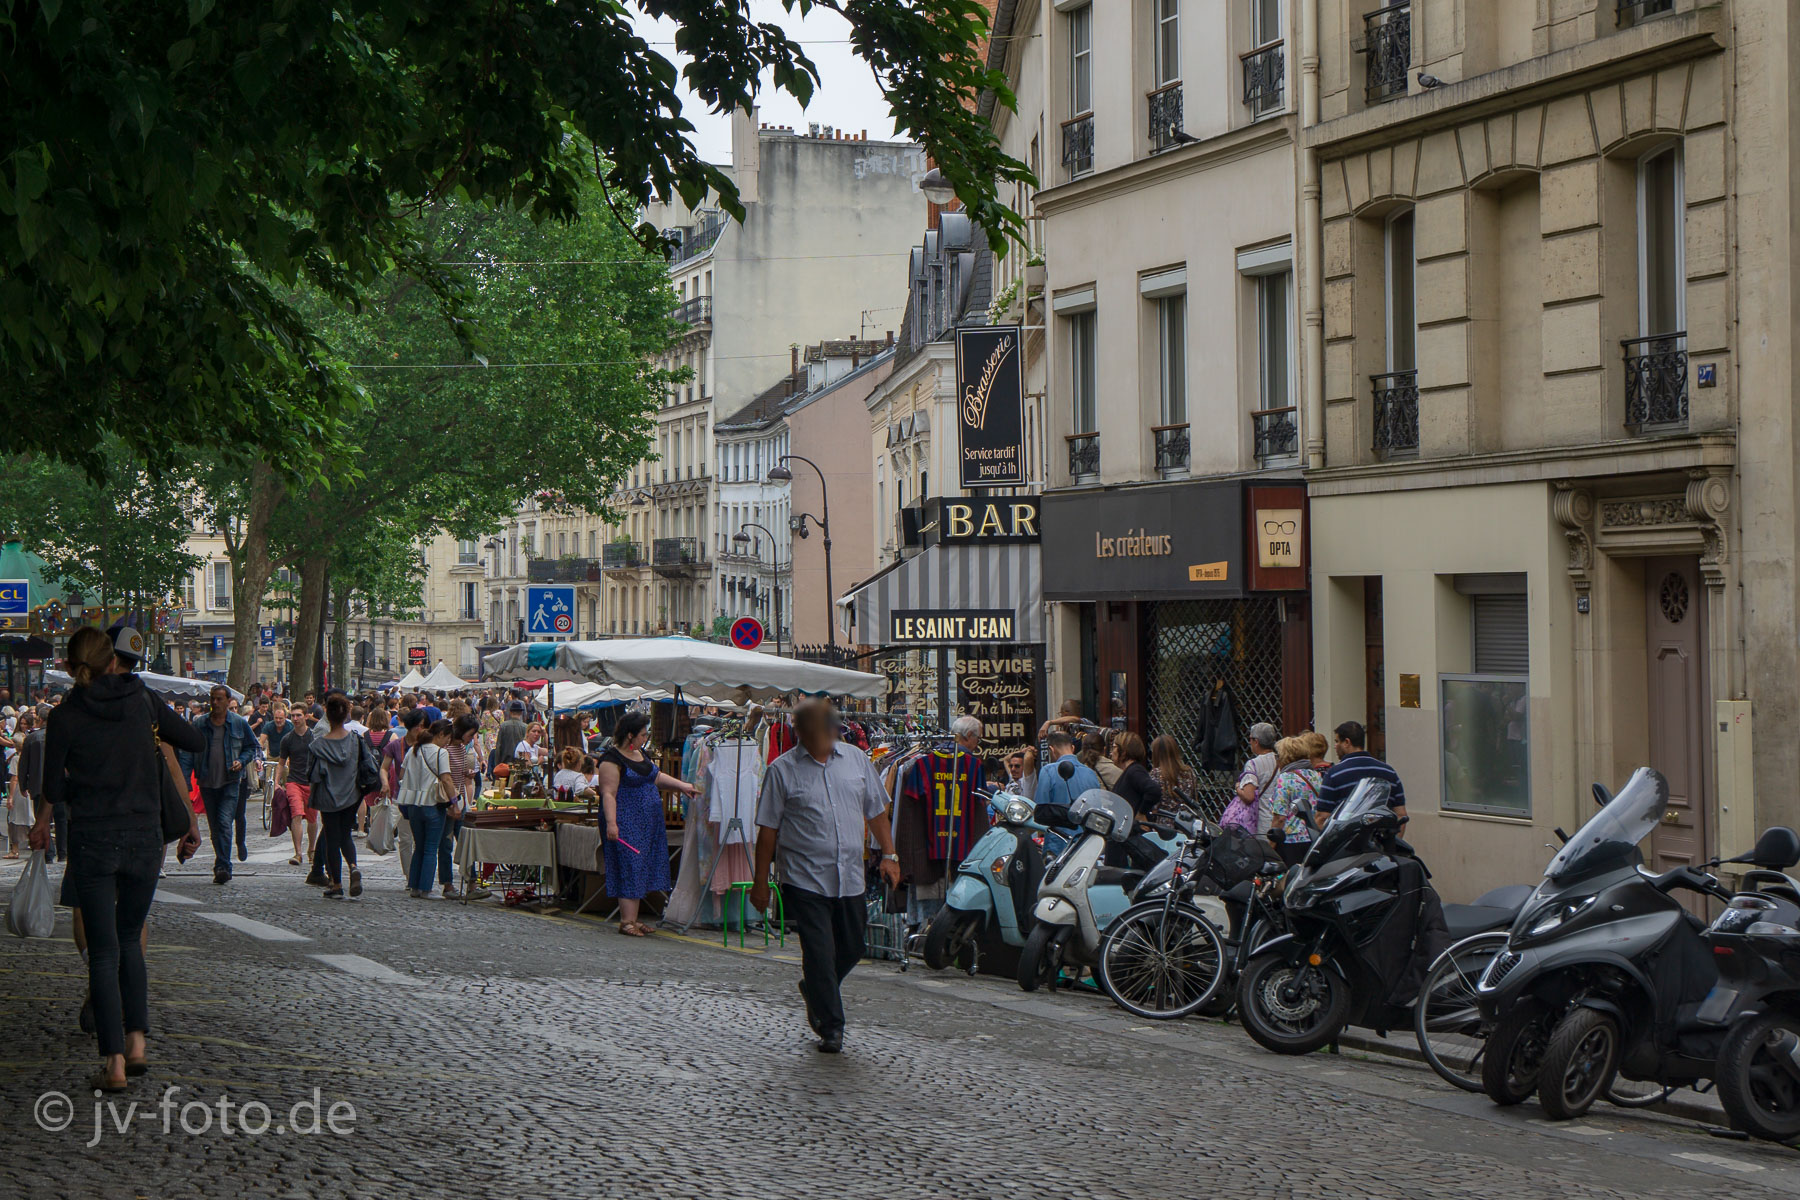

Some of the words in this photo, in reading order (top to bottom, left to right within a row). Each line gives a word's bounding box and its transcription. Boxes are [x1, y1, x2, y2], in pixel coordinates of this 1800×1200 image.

[963, 334, 1012, 429] Brasserie
[1699, 366, 1713, 384] 27
[964, 447, 993, 460] Service
[993, 446, 1016, 459] tardif
[979, 462, 1007, 478] jusqu'à
[1007, 462, 1017, 475] 1h
[945, 503, 1038, 538] BAR
[1096, 531, 1115, 558] Les
[1116, 527, 1172, 557] créateurs
[1269, 541, 1291, 556] OPTA
[558, 619, 569, 627] 20
[895, 618, 914, 639] LE
[916, 617, 966, 639] SAINT
[968, 617, 1011, 639] JEAN
[881, 658, 935, 676] Concert
[954, 659, 1033, 675] SERVICE
[886, 680, 935, 694] JAZZ
[962, 675, 1030, 699] Continu
[968, 701, 988, 715] 7h
[989, 702, 999, 715] à
[1000, 700, 1014, 715] 1h
[1014, 706, 1034, 714] matin
[983, 722, 1025, 737] NER
[958, 773, 968, 782] JR
[935, 782, 962, 817] 11
